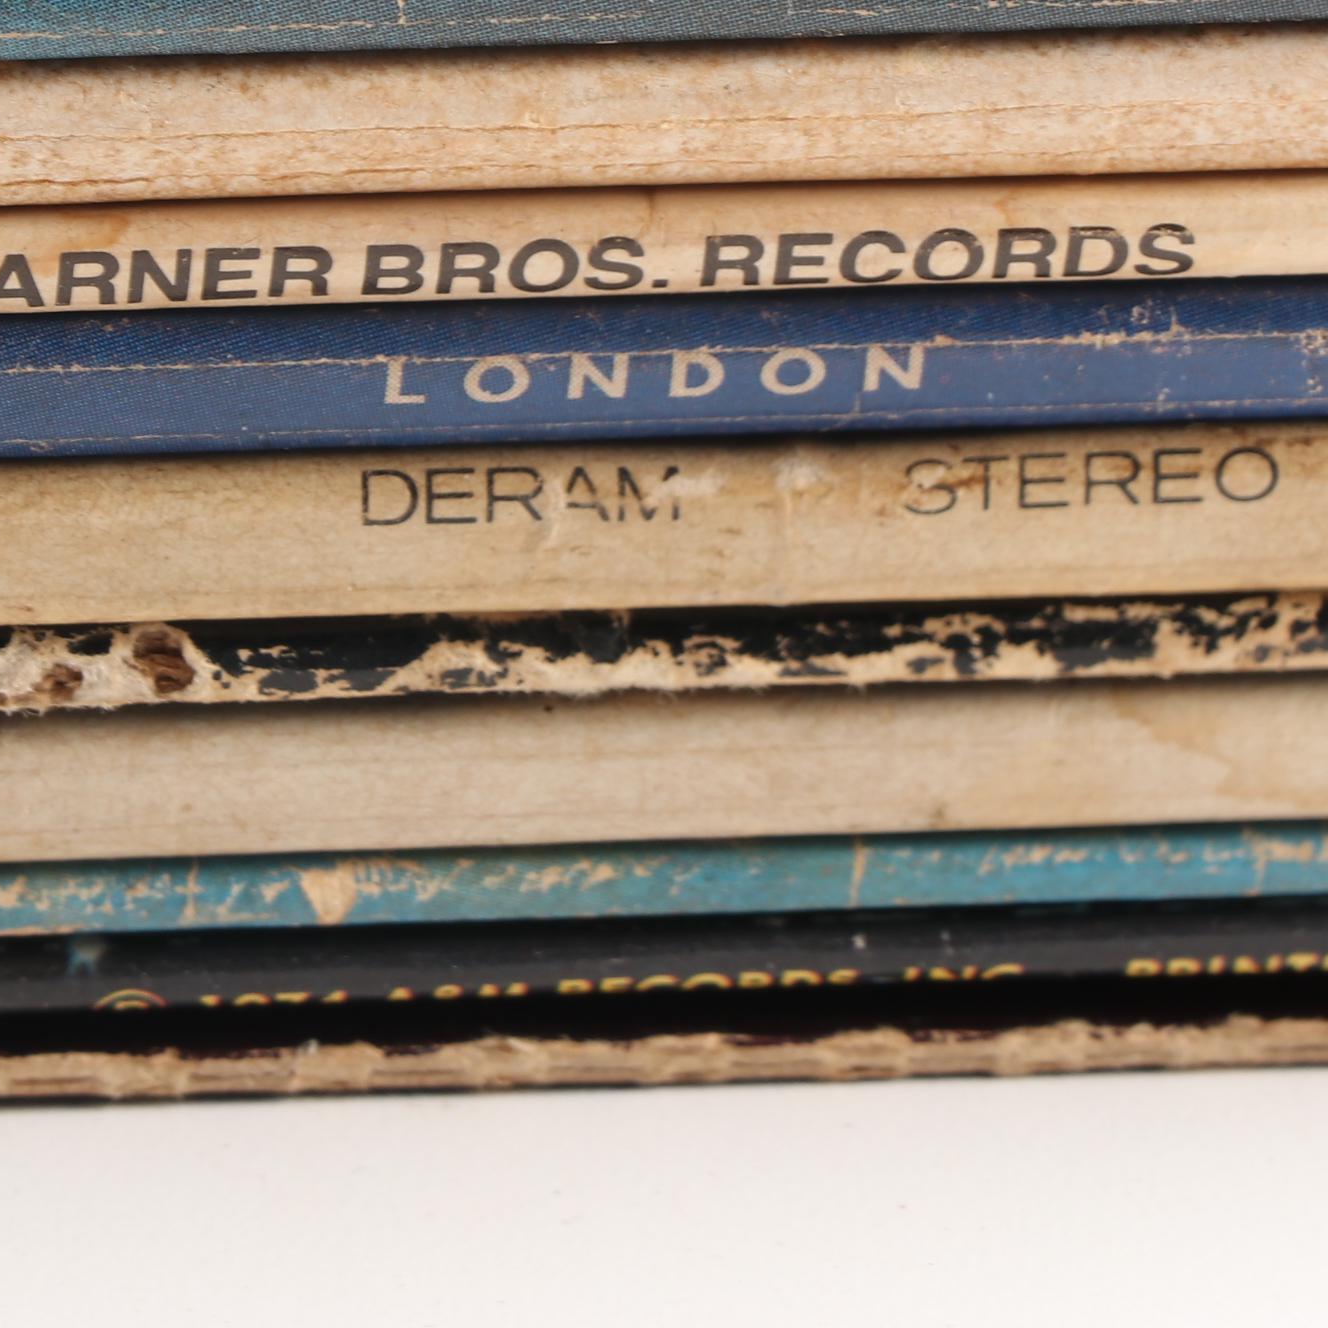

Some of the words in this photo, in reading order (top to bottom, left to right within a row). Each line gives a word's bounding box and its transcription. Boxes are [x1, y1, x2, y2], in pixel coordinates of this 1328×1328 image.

[360, 235, 670, 296] BROS.
[699, 222, 1197, 288] RECORDS
[382, 345, 927, 405] LONDON
[361, 465, 681, 527] DERAM
[903, 446, 1280, 516] STEREO
